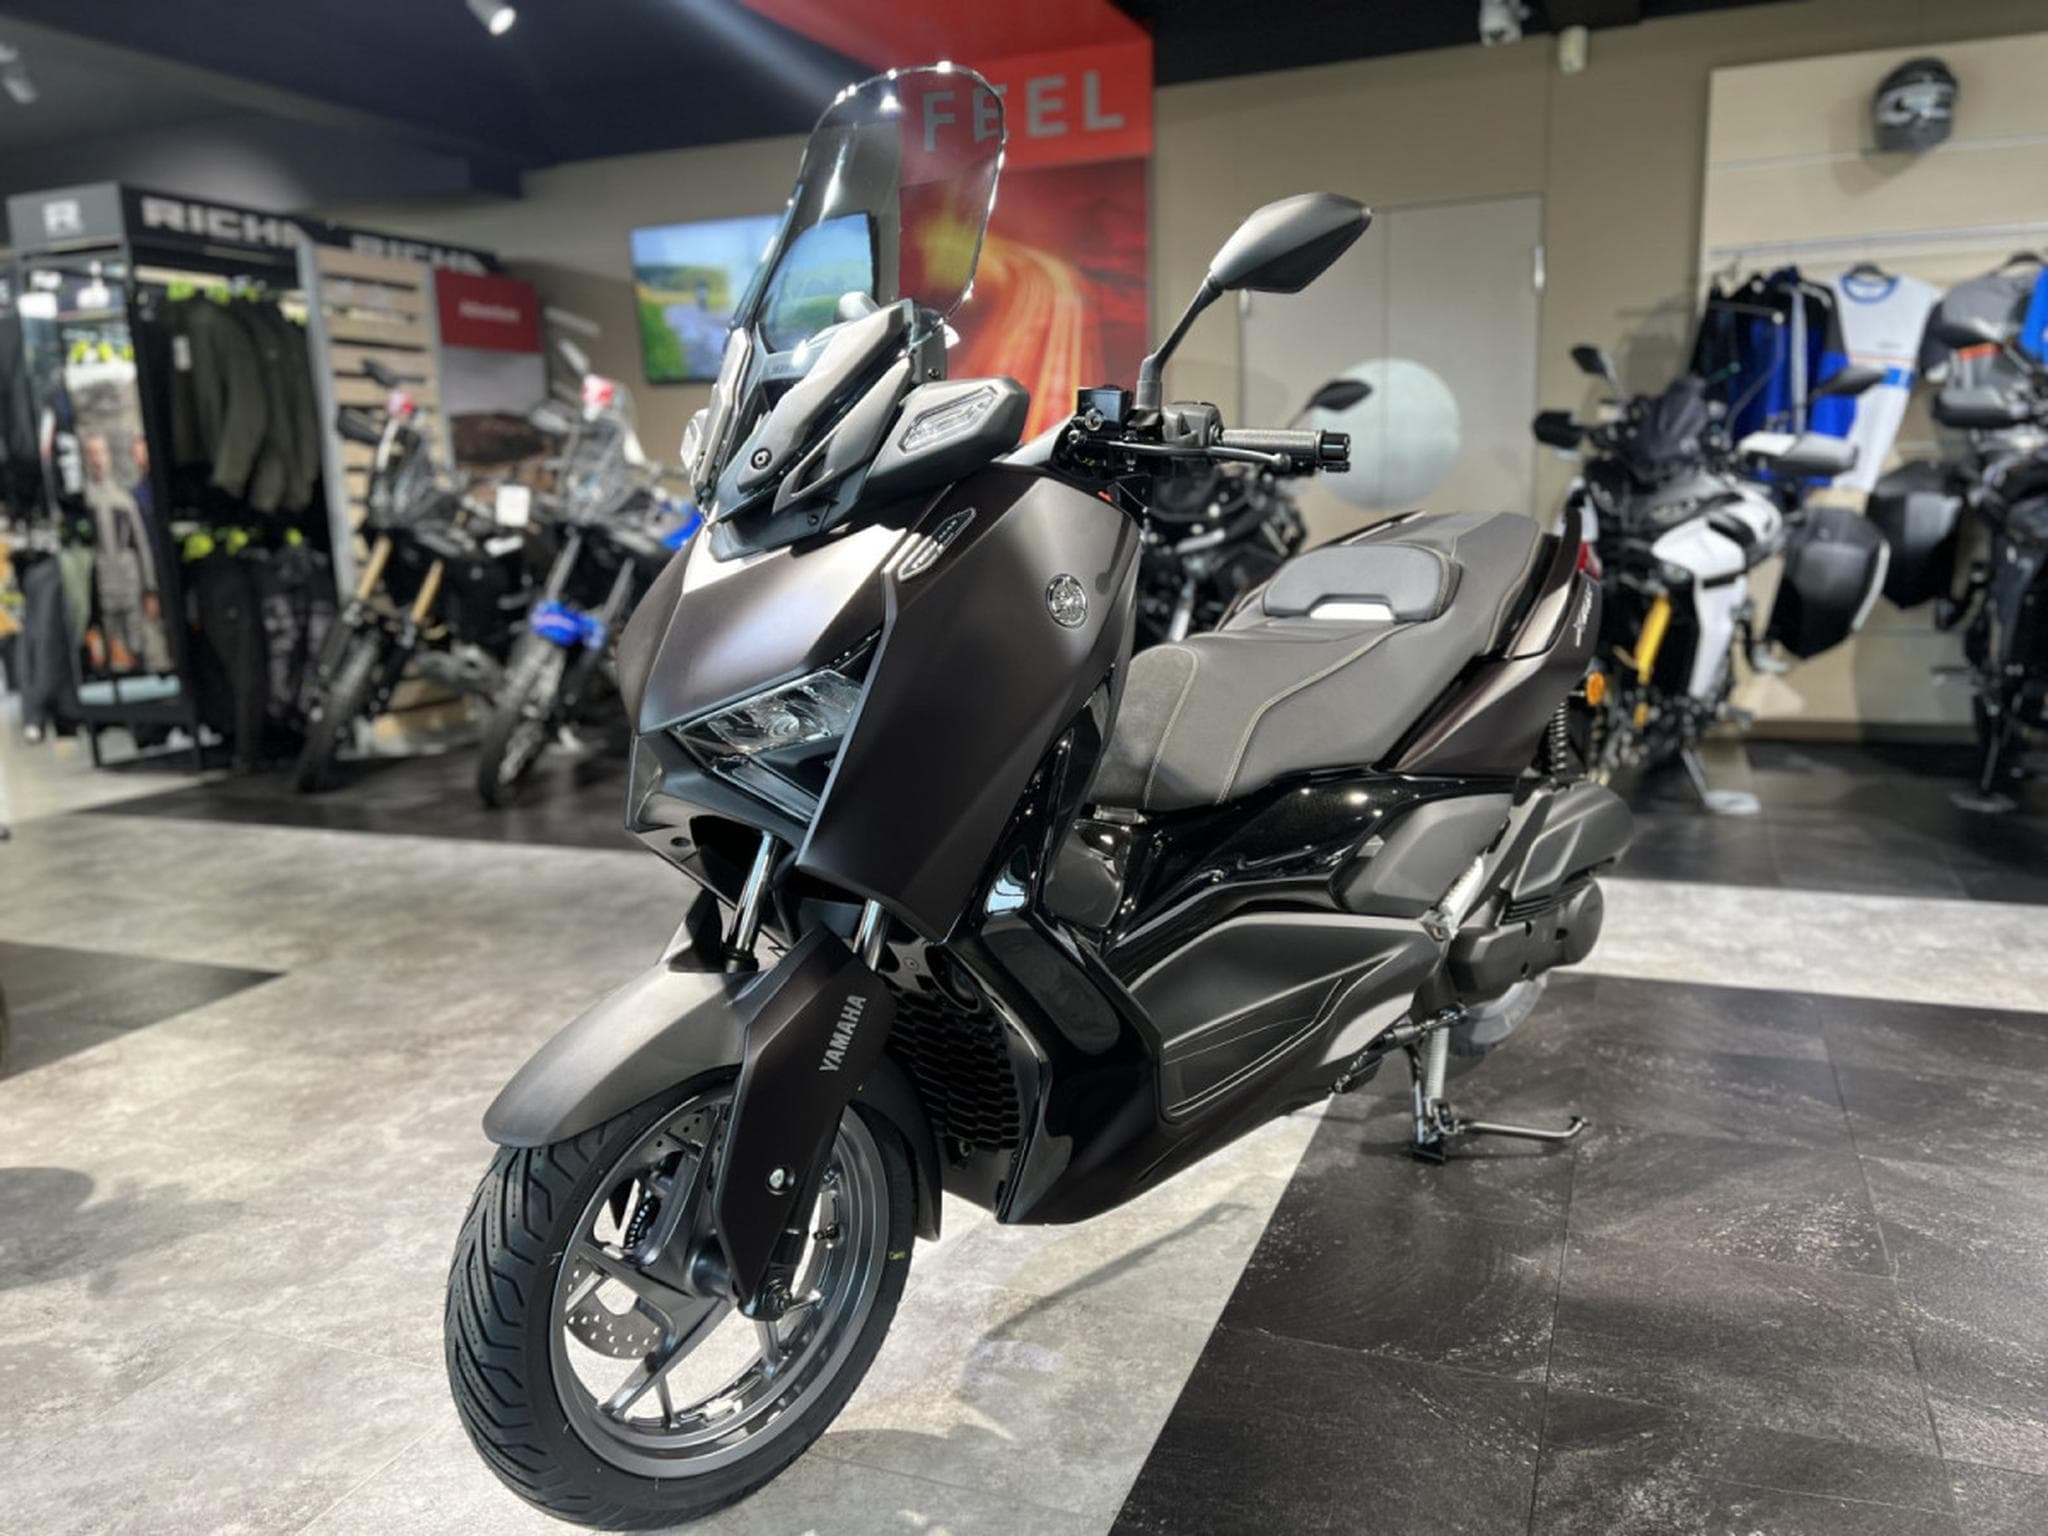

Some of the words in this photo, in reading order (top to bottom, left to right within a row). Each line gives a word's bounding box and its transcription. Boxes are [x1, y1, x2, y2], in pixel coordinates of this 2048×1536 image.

[922, 70, 1124, 151] FEEL
[42, 200, 83, 236] R
[819, 995, 867, 1071] YAMAHA
